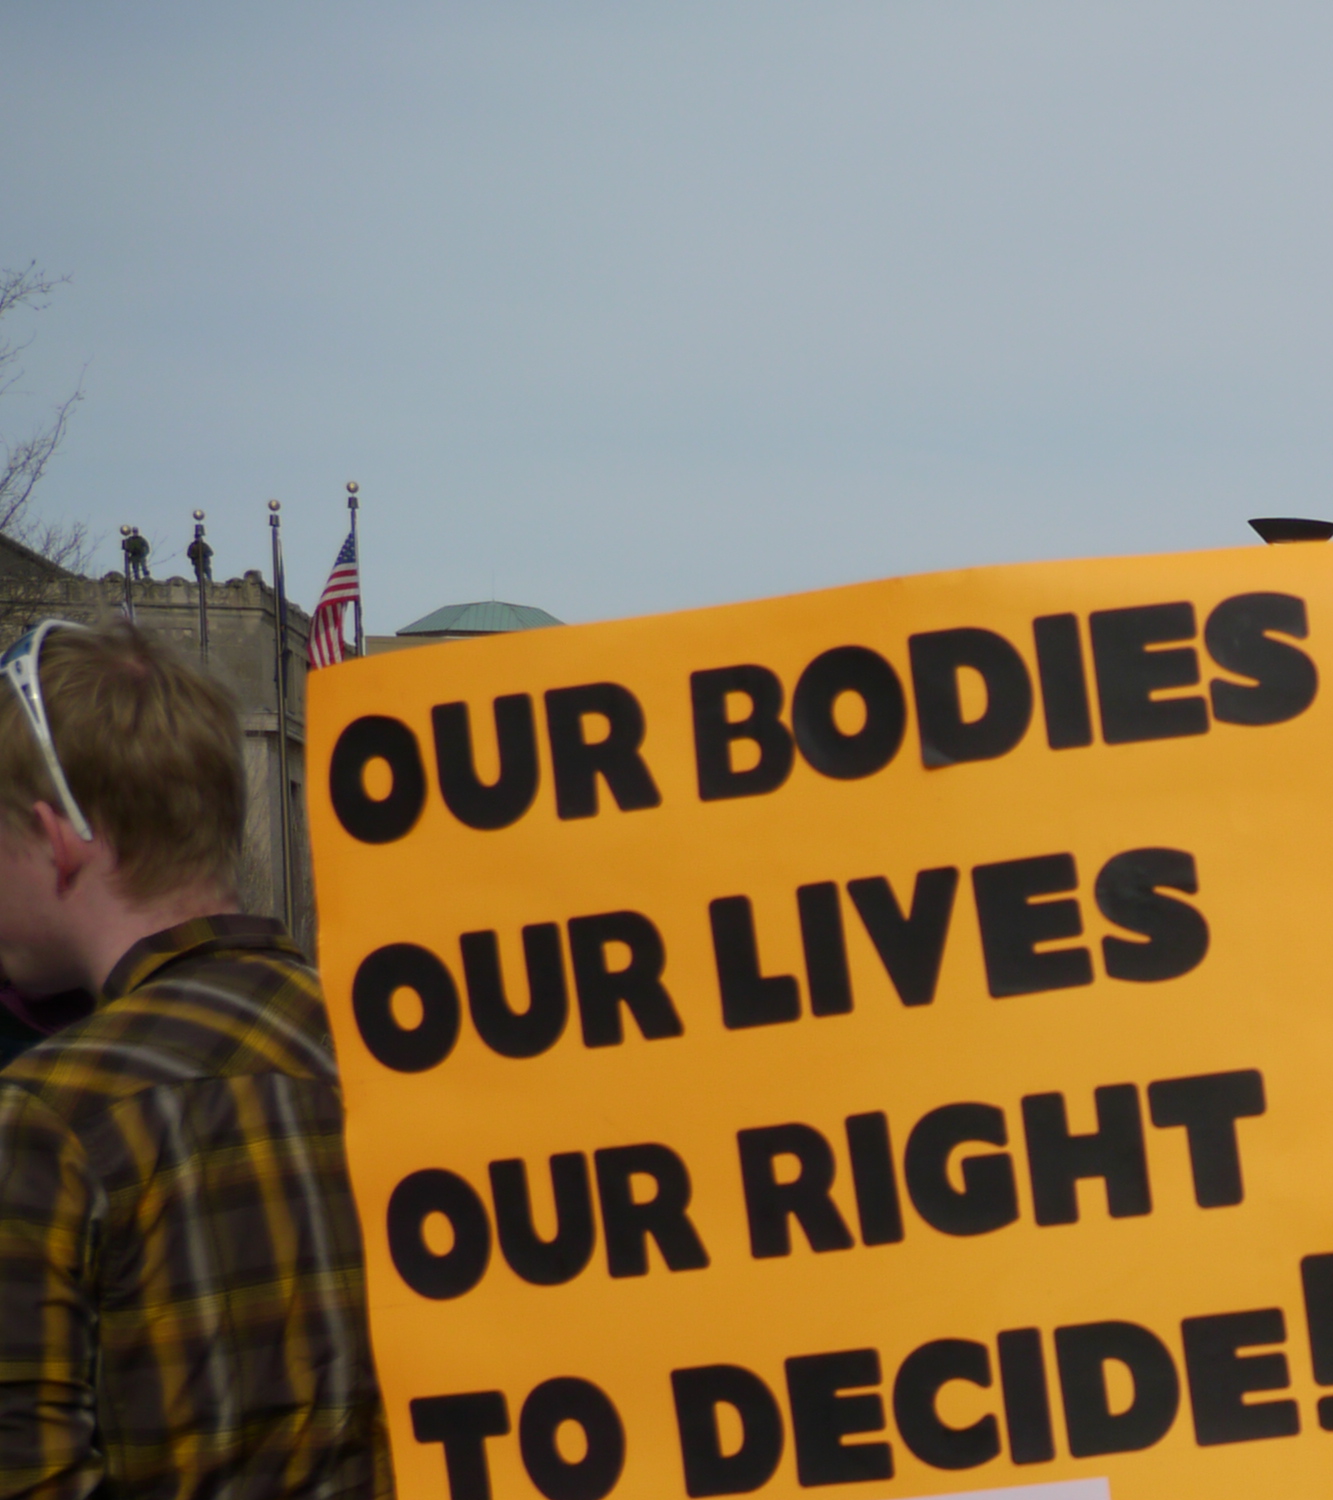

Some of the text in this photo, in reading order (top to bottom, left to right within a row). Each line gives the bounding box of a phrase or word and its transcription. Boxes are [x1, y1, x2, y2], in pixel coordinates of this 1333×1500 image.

[330, 594, 1316, 844] OUR BODIES
[352, 849, 1208, 1072] OUR LIVES
[387, 1071, 1264, 1299] OUR RIGHT
